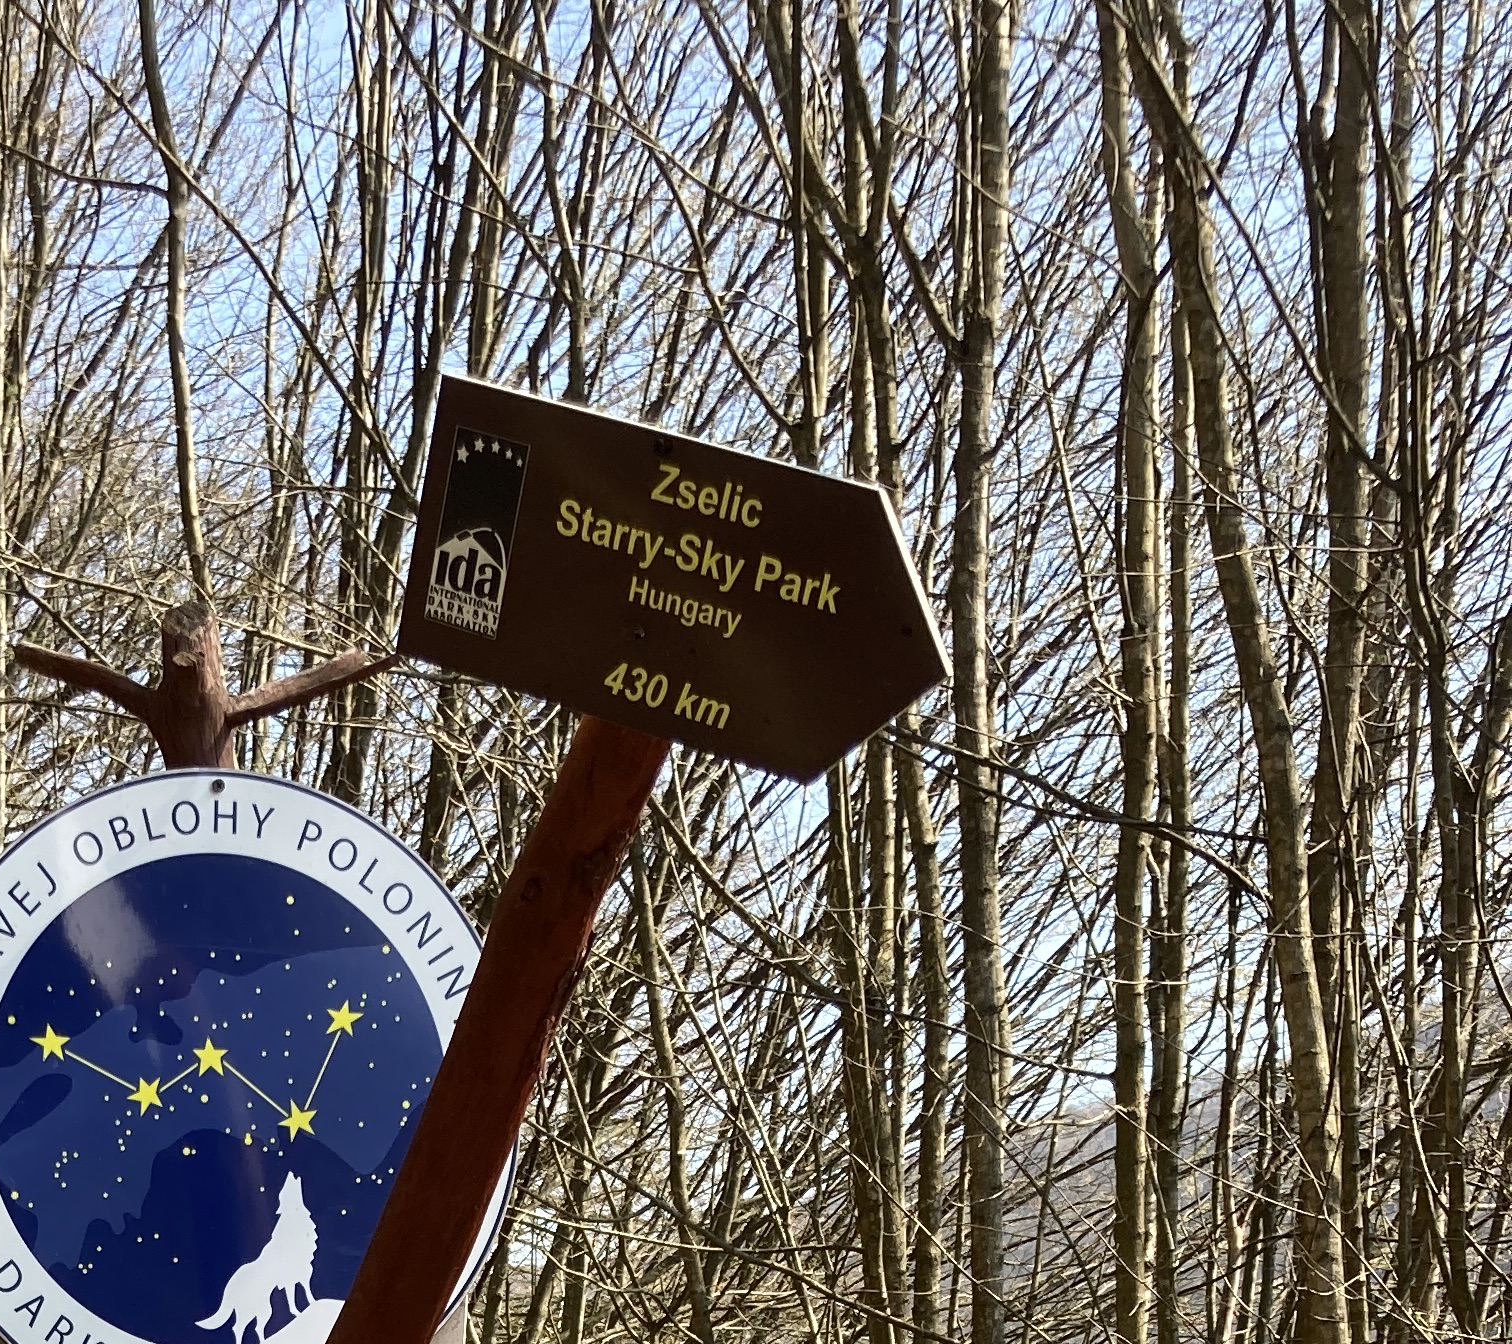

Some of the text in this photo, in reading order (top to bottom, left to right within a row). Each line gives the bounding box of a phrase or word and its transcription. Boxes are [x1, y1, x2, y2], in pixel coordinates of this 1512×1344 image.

[650, 464, 763, 529] Zselic
[555, 499, 841, 614] Starry-Sky Park
[427, 608, 496, 635] ASSOCIATION
[430, 585, 499, 613] INTERNATIONAL
[628, 575, 742, 638] Hungary
[603, 663, 731, 731] 430 km
[71, 800, 276, 867] OBLOHY
[297, 819, 471, 1001] POLONIN
